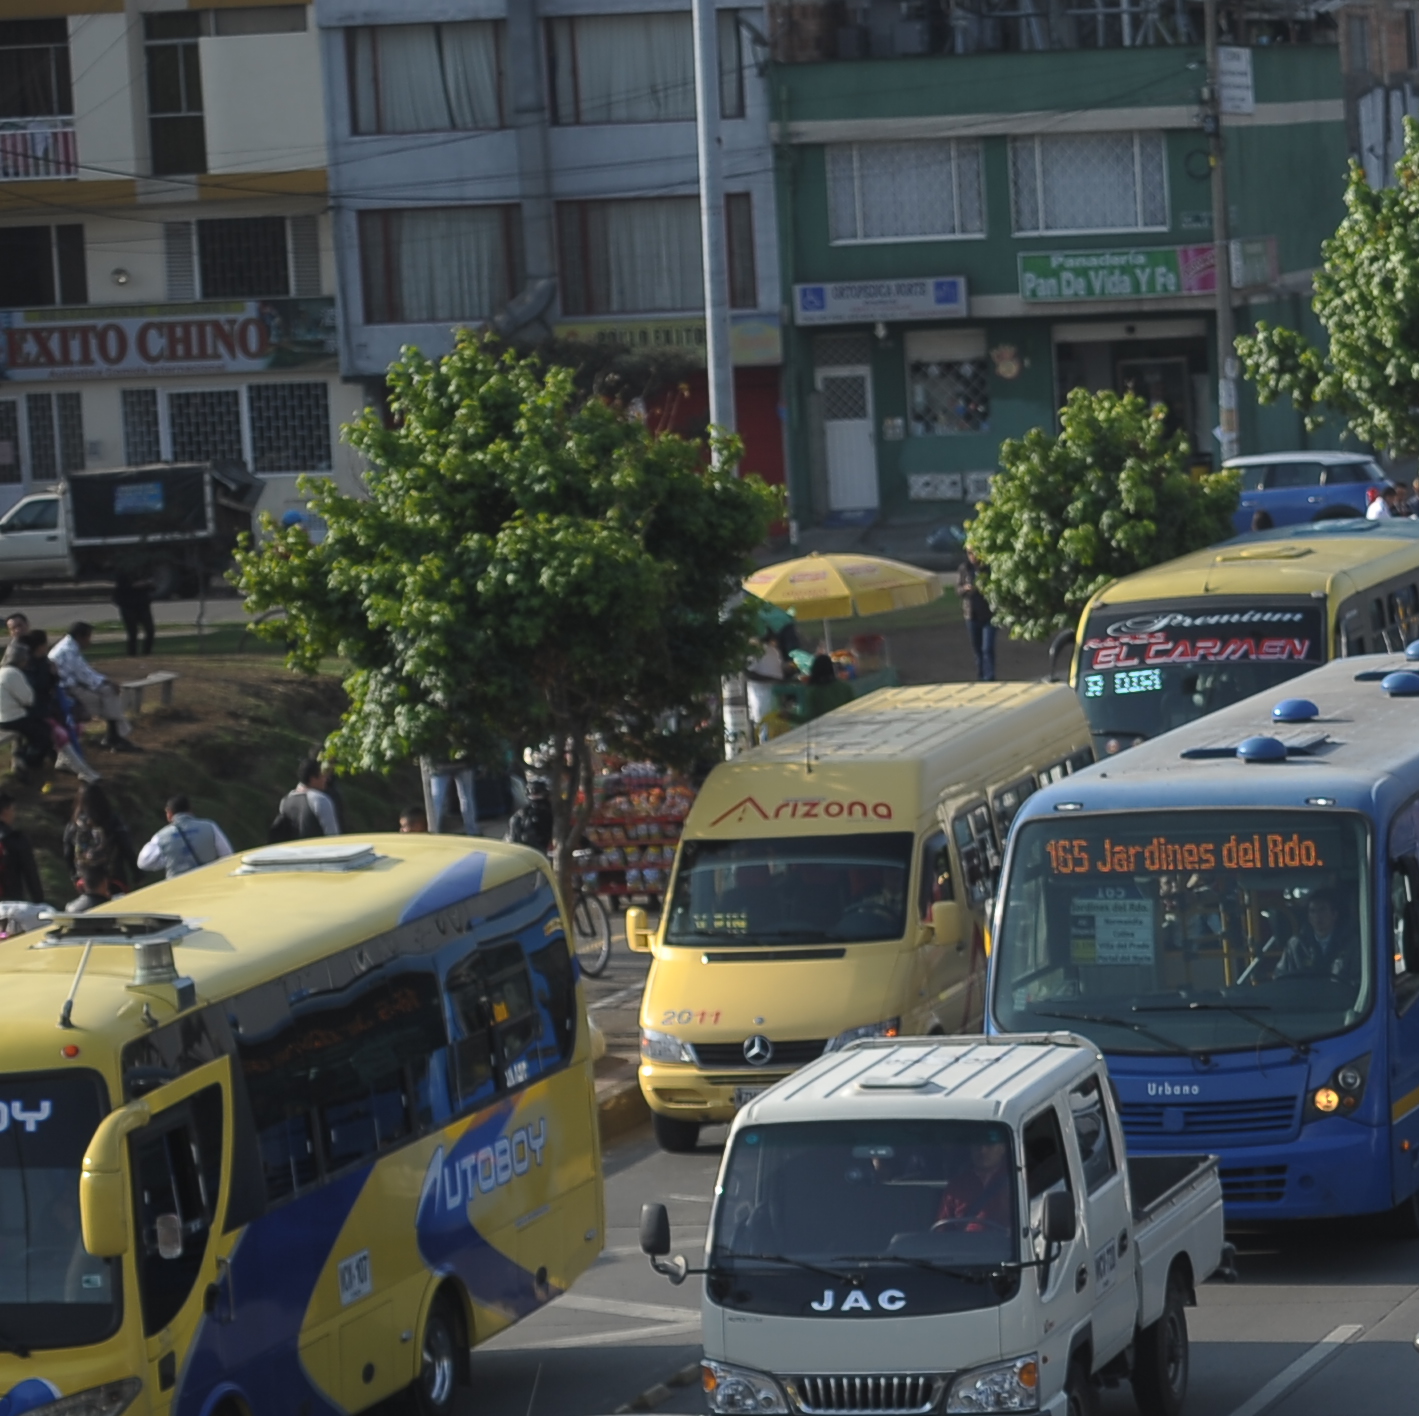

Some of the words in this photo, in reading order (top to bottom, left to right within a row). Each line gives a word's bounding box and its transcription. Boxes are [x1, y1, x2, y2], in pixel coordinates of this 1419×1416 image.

[1023, 271, 1059, 297] Pan
[1061, 271, 1087, 296] De
[1088, 266, 1133, 295] Vida
[1134, 266, 1152, 293] Y
[1155, 264, 1178, 292] Fe
[5, 323, 128, 370] EXITO
[136, 318, 269, 365] CHINO
[1092, 644, 1140, 670] EL
[1144, 639, 1310, 665] CARMEN
[708, 796, 894, 828] Arizona
[1045, 838, 1091, 874] 165
[1096, 837, 1217, 873] Jardines
[1222, 834, 1262, 869] del
[1266, 833, 1324, 869] Rdo.
[661, 1010, 721, 1026] 2011
[1147, 1081, 1200, 1096] Urbano
[415, 1116, 547, 1228] AUTOBOY
[810, 1289, 907, 1311] JAC
